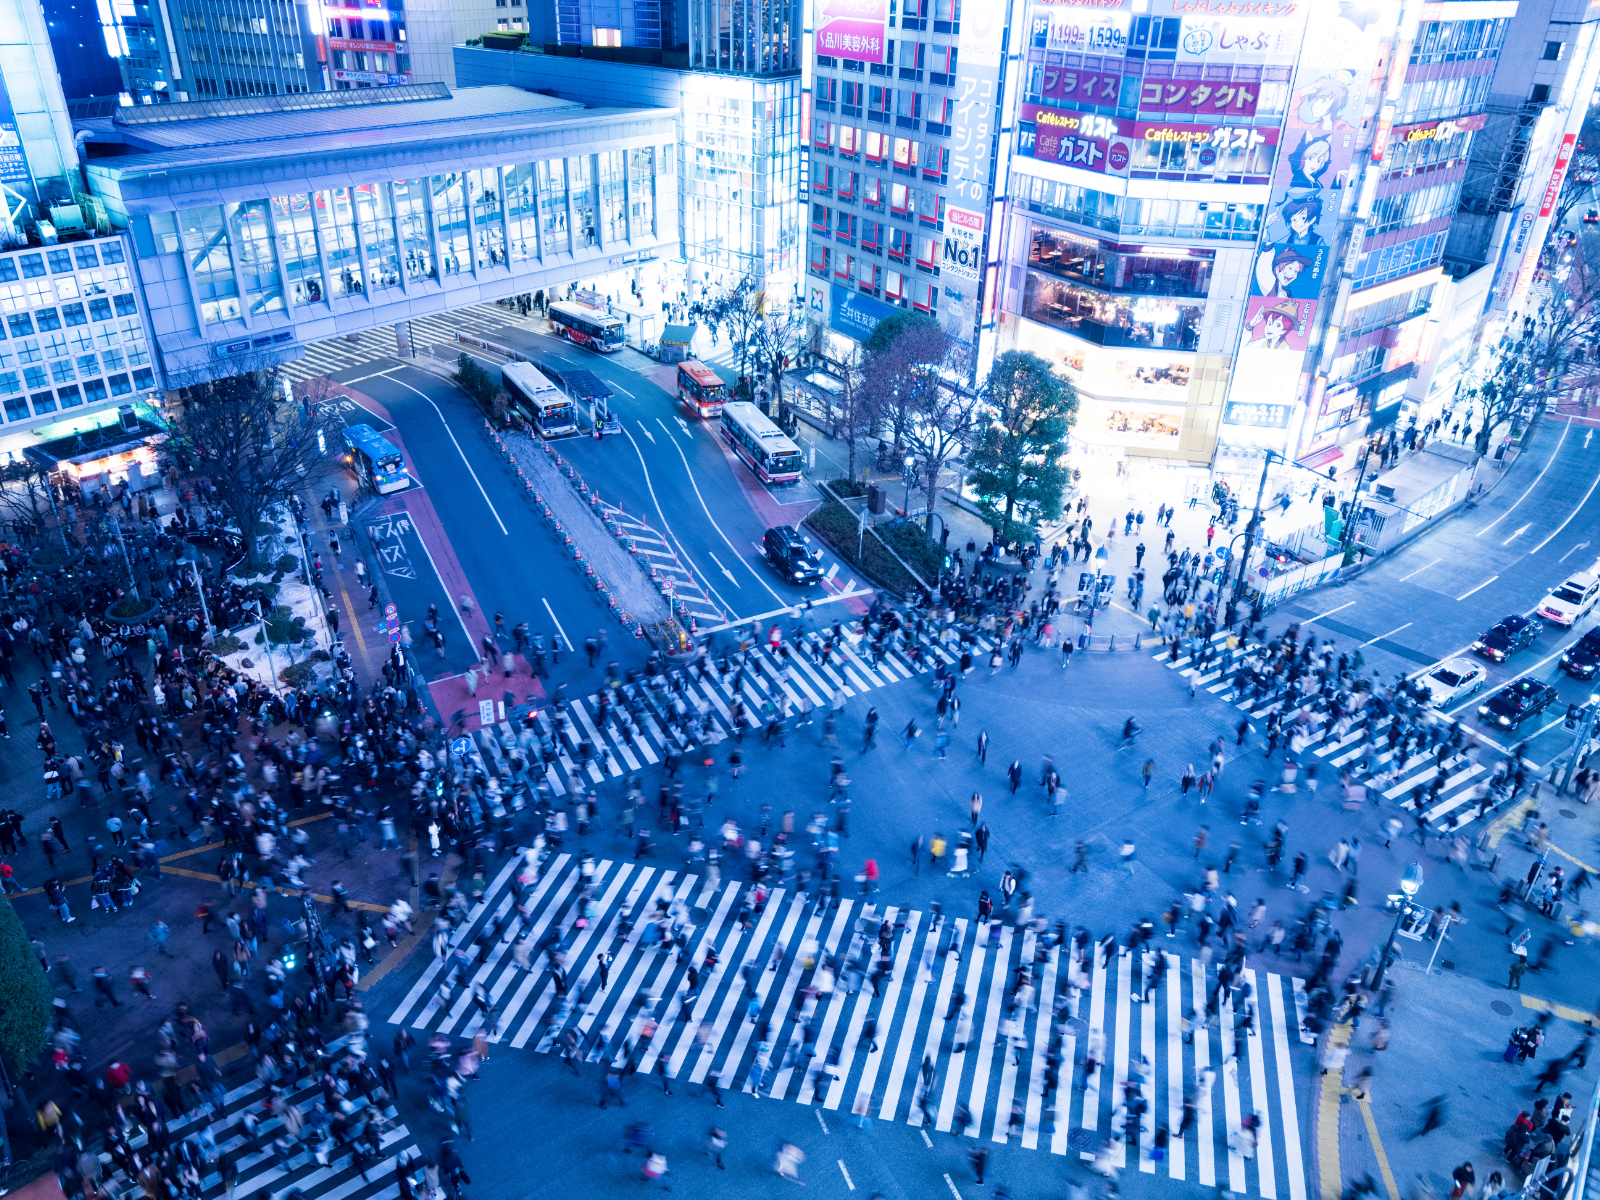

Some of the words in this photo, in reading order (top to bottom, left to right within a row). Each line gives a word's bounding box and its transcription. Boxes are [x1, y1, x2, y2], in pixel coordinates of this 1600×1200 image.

[1034, 19, 1047, 33] 9F
[825, 31, 880, 55] 品川美容外科
[963, 42, 996, 58] eyecity
[1220, 27, 1296, 51] しゃぶ葉
[1045, 71, 1118, 98] プライス
[1142, 83, 1255, 109] コンタクト
[953, 76, 977, 197] アイシティ
[1020, 131, 1036, 147] 7F
[1080, 115, 1118, 139] ガスト
[1211, 127, 1266, 149] ガスト
[970, 79, 992, 201] コンタクトの
[1039, 135, 1058, 148] Café
[1058, 136, 1103, 165] ガスト
[1111, 154, 1127, 163] ガスト
[1543, 167, 1565, 209] TaxFree
[951, 211, 981, 229] 当ビル5階
[943, 235, 980, 271] No.1
[941, 262, 978, 280] コンタクトショップ
[840, 304, 879, 329] 三井住友信
